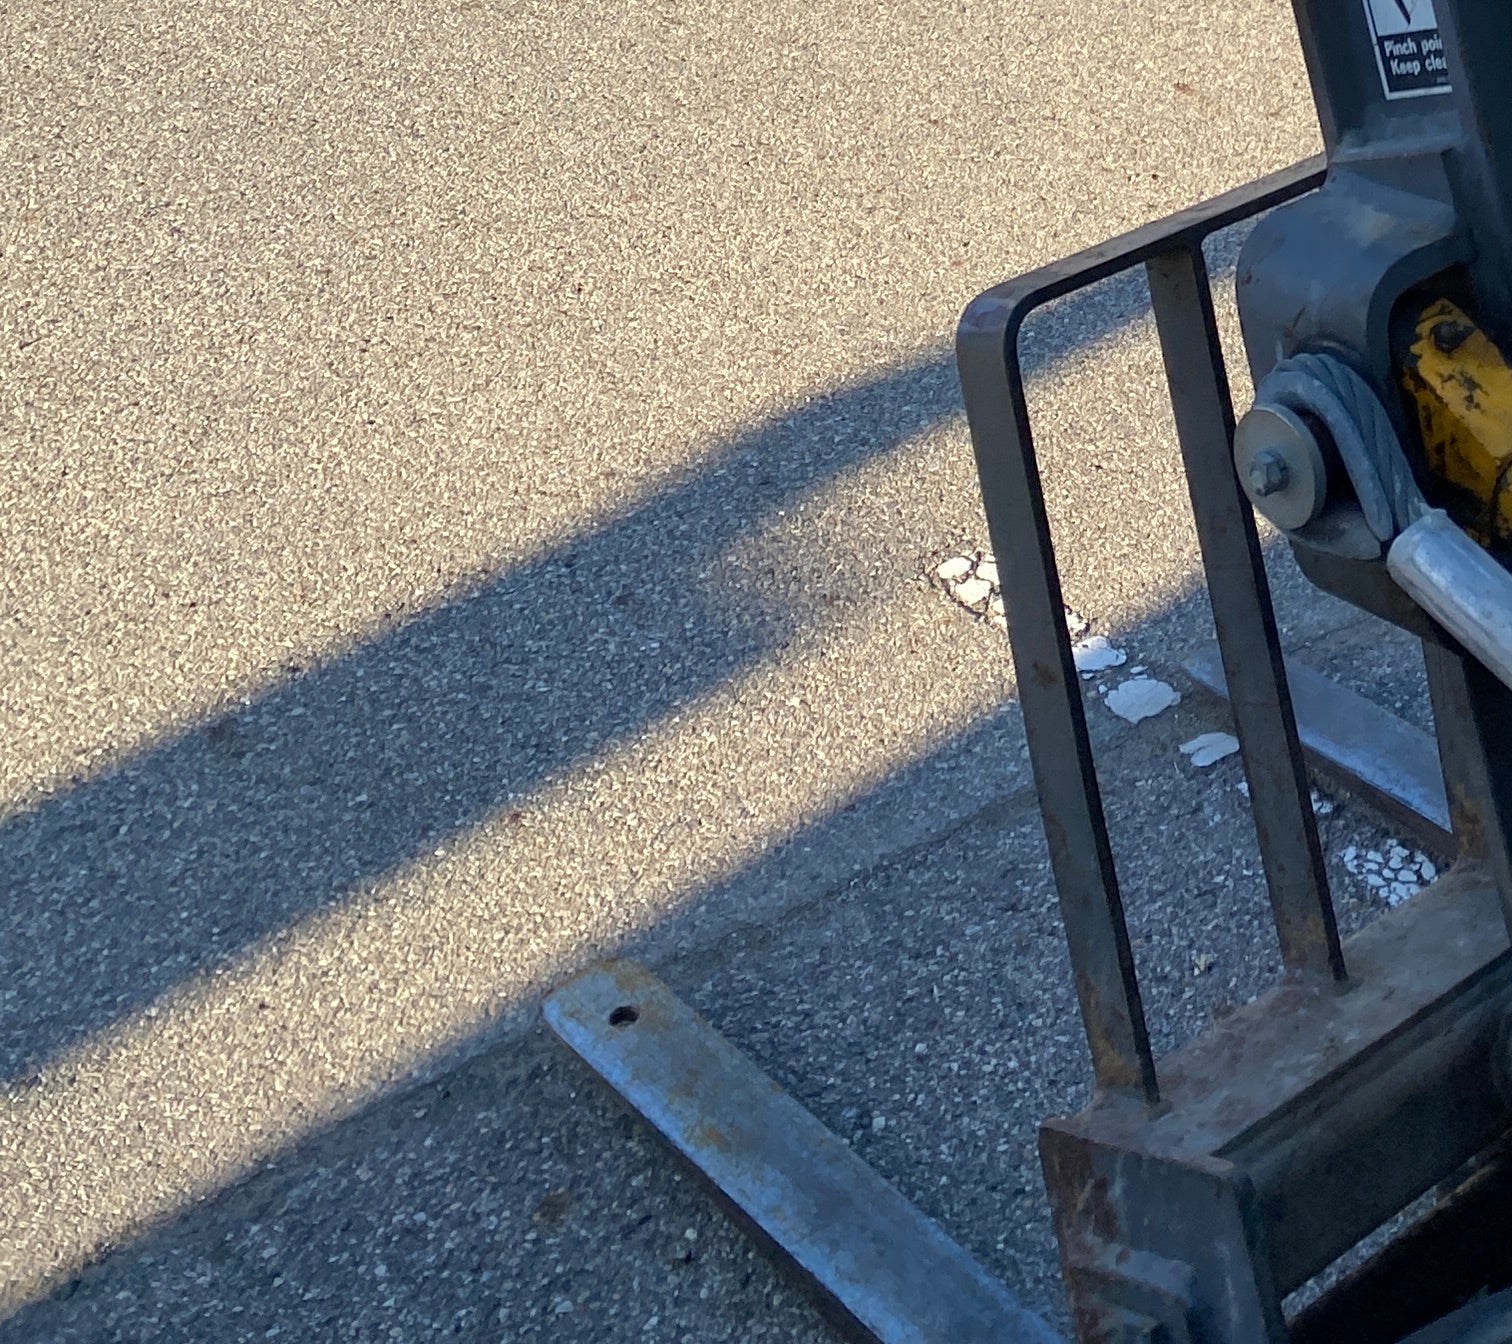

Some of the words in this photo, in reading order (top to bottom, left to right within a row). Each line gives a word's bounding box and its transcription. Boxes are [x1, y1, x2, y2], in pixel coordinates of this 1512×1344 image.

[1384, 37, 1418, 58] Pinch
[1390, 58, 1421, 76] Keep
[1425, 53, 1447, 71] clea
